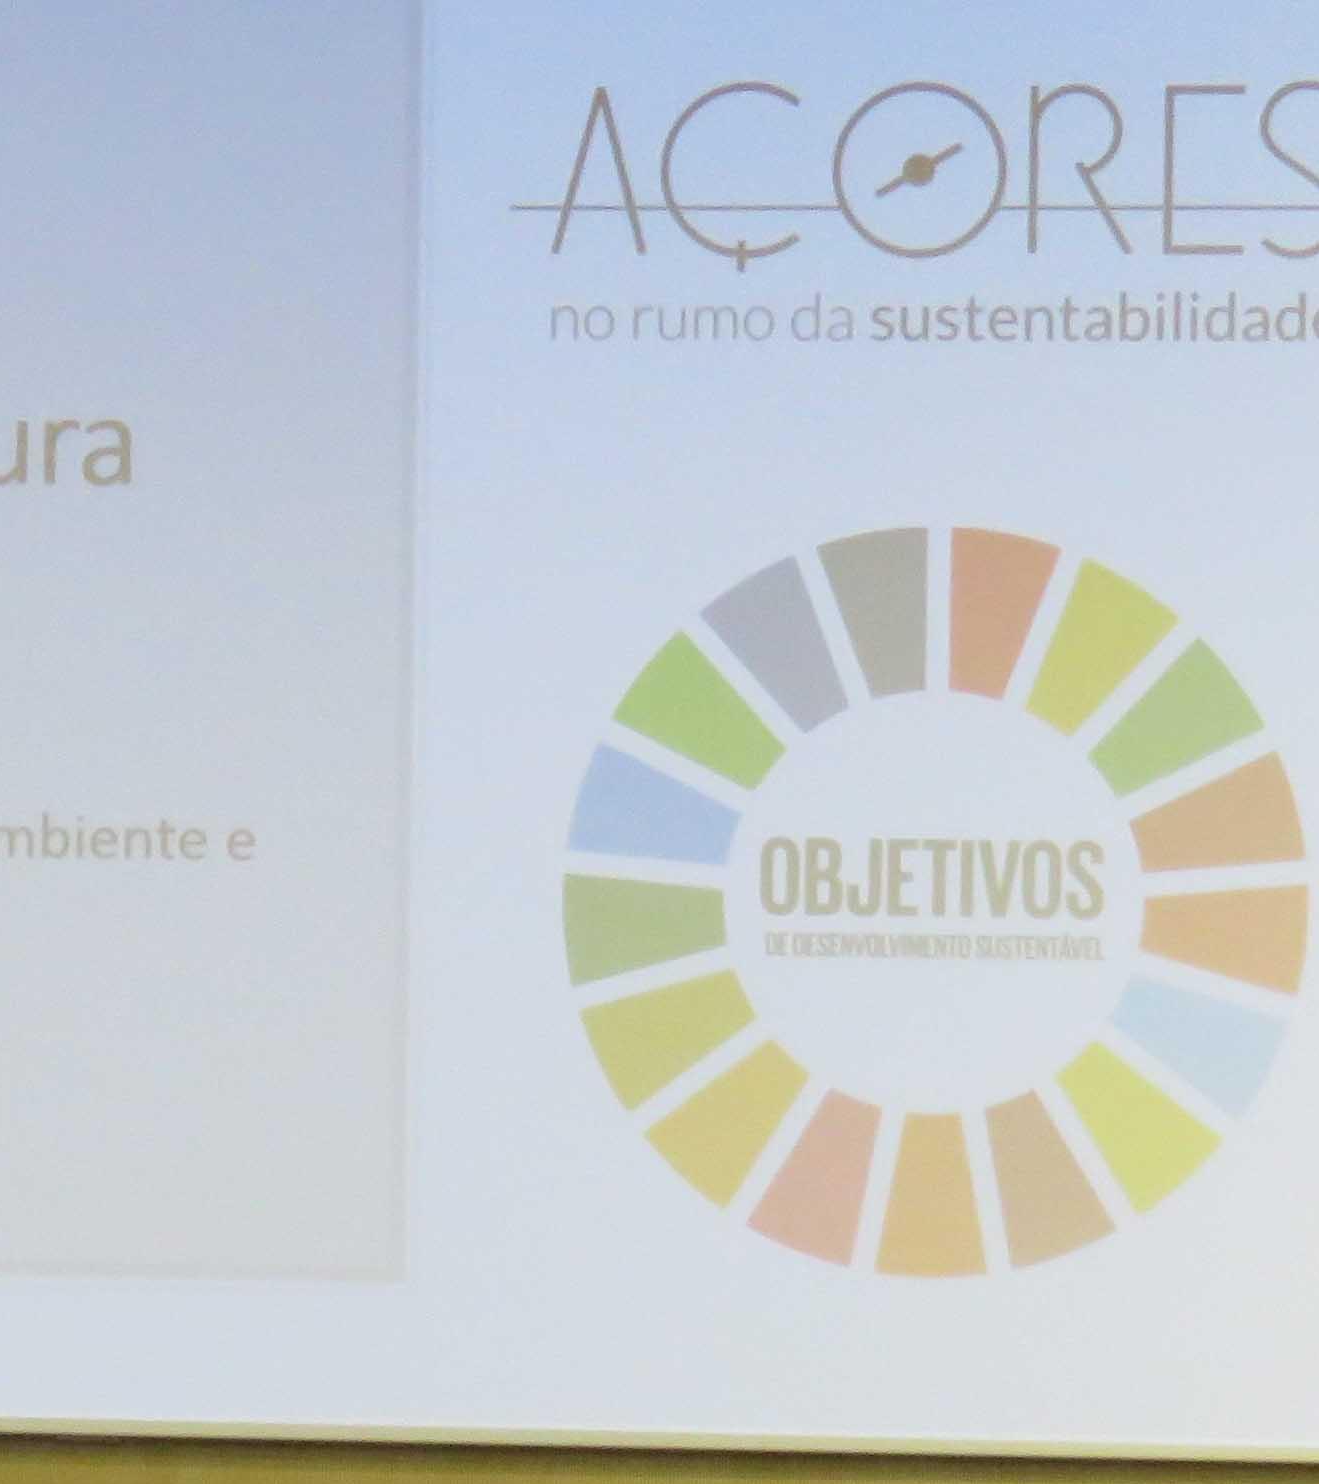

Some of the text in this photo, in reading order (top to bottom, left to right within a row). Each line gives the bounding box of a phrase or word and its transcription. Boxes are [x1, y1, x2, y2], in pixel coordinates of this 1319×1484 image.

[550, 301, 615, 343] no
[630, 302, 776, 343] rumo
[789, 292, 856, 343] da
[225, 831, 258, 863] e
[760, 837, 1105, 920] OBJETIVOS
[765, 931, 788, 957] DE
